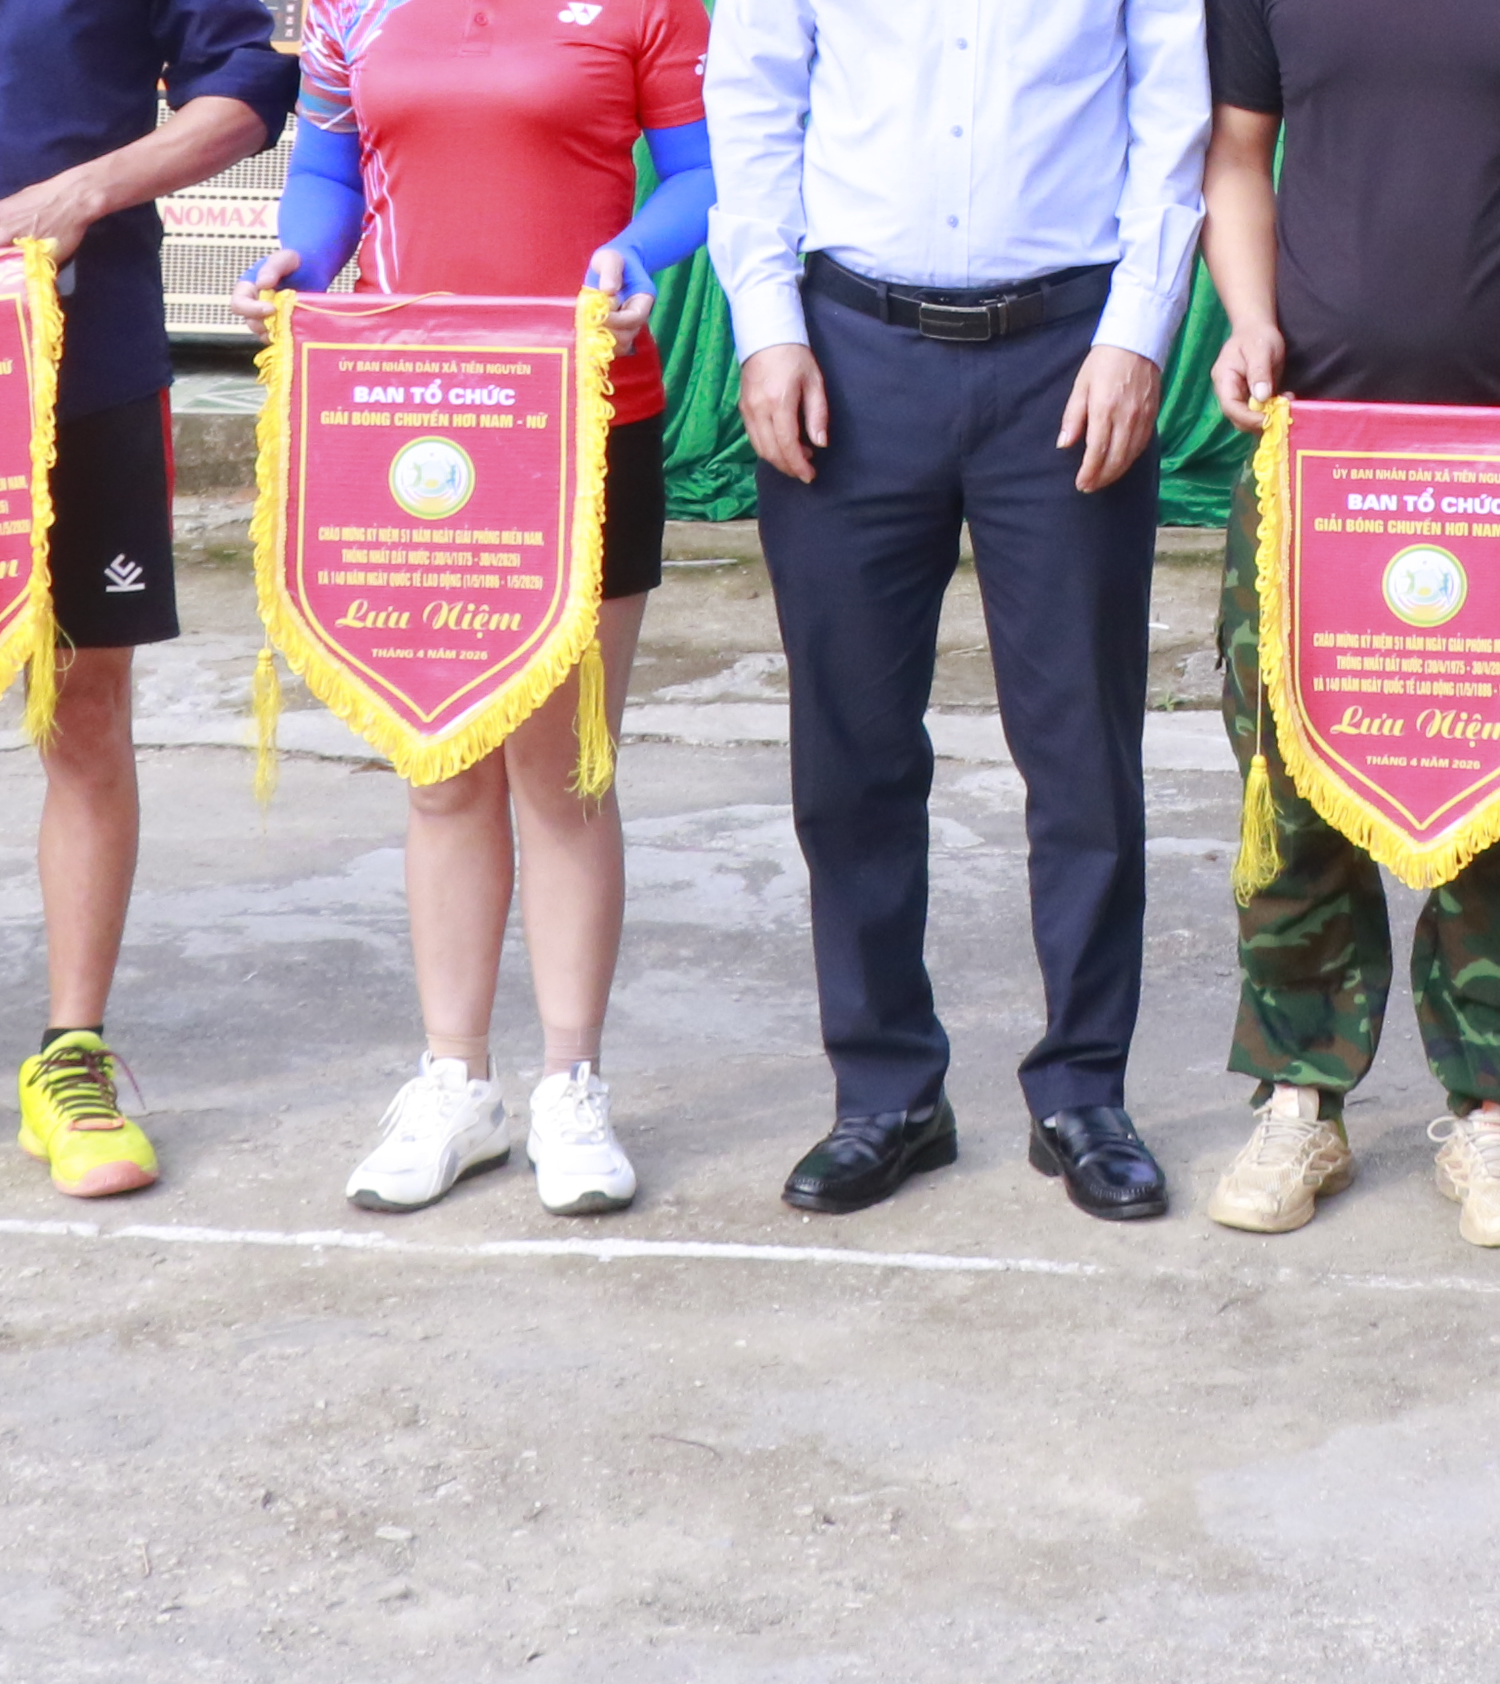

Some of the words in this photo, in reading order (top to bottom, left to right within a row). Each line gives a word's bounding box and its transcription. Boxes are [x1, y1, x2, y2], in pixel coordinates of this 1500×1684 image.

[354, 386, 405, 403] BAN
[410, 378, 443, 404] TỔ
[448, 385, 515, 406] CHỨC
[1350, 469, 1374, 480] BAN
[1348, 494, 1398, 511] BAN
[1403, 487, 1435, 513] TỔ
[1314, 513, 1343, 532] GIẢI
[1345, 517, 1384, 533] BÓNG
[1445, 522, 1469, 536] HƠI
[335, 599, 410, 629] Lưu
[423, 601, 522, 639] Niệm
[371, 647, 414, 658] THÁNG
[416, 649, 425, 658] 4
[427, 648, 457, 659] NĂM
[459, 650, 488, 660] 2026
[1330, 705, 1404, 736] Lưu
[1366, 754, 1407, 766] THÁNG
[1410, 758, 1418, 766] 4
[1420, 756, 1450, 768] NĂM
[1452, 759, 1481, 770] 2026
